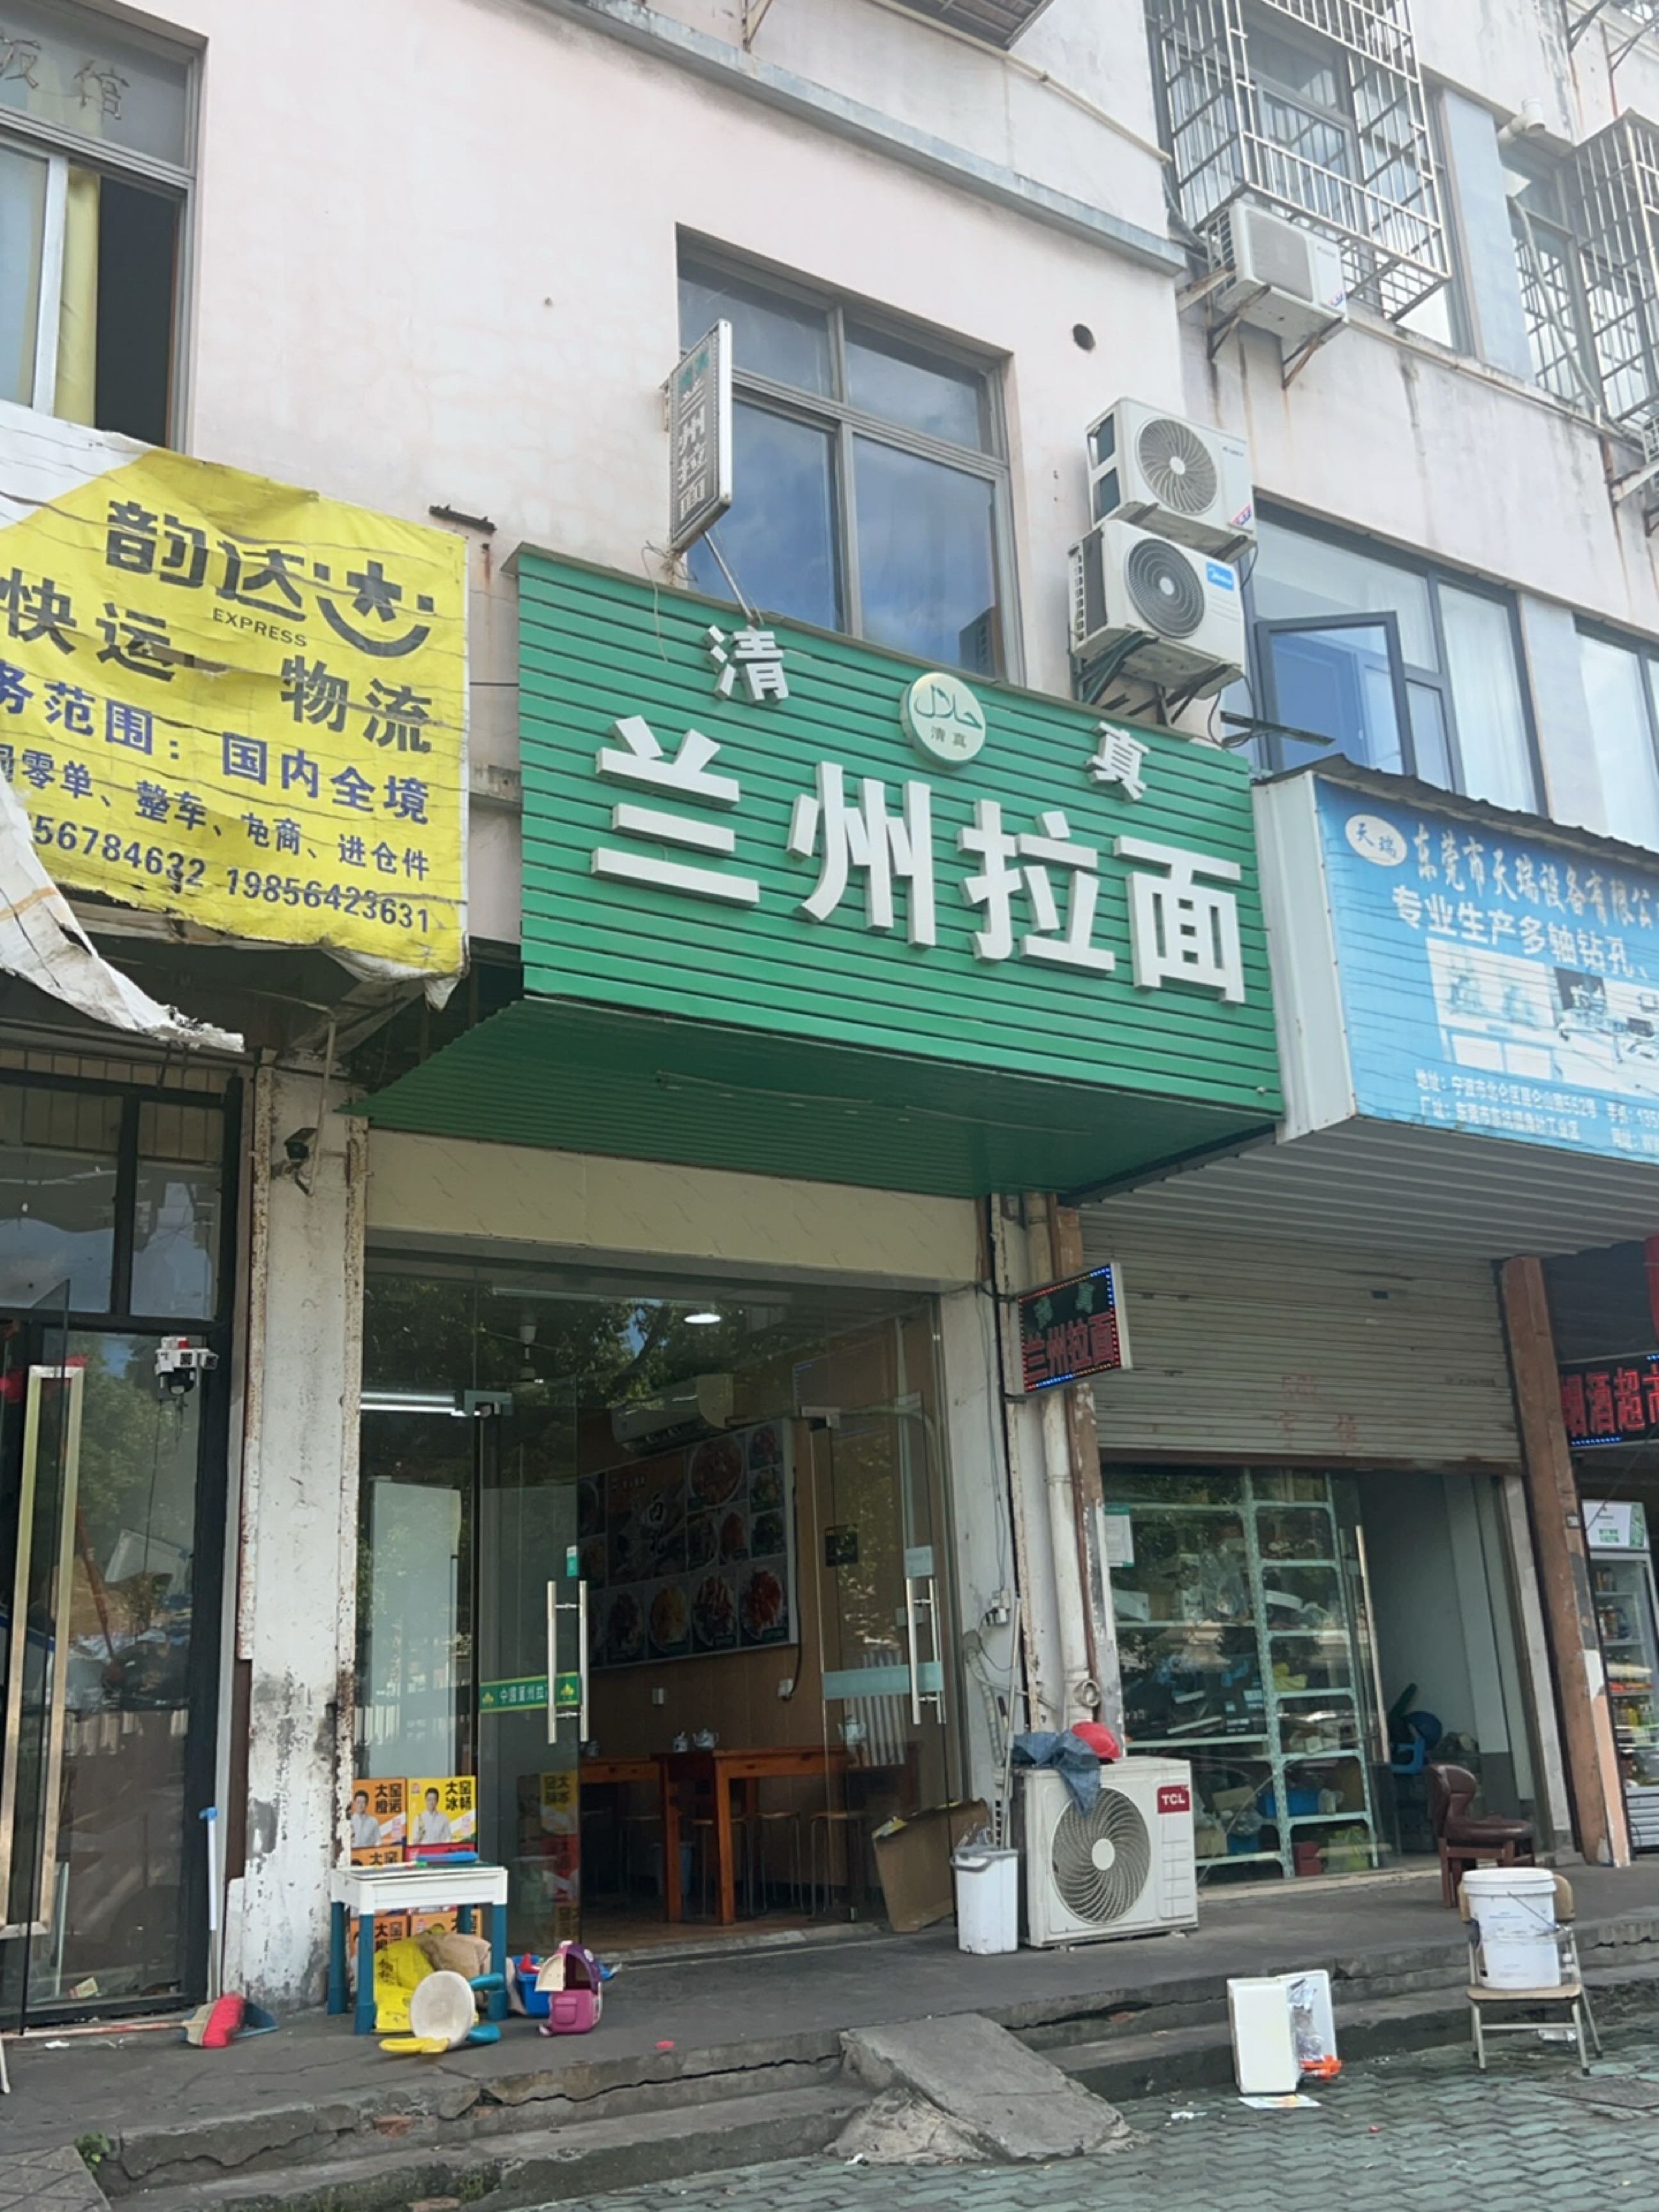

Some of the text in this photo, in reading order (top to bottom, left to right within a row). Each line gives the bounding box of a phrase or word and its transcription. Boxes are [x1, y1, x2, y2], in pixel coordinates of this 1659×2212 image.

[0, 568, 432, 753] 快运 物流
[213, 607, 307, 647] EXPRESS
[704, 623, 789, 703] 清
[1085, 721, 1149, 802] 真
[28, 812, 429, 933] 56784632 19856423631
[591, 714, 1246, 1005] 兰州拉面
[1024, 1311, 1115, 1382] 兰州拉面
[1160, 1793, 1186, 1806] TCL
